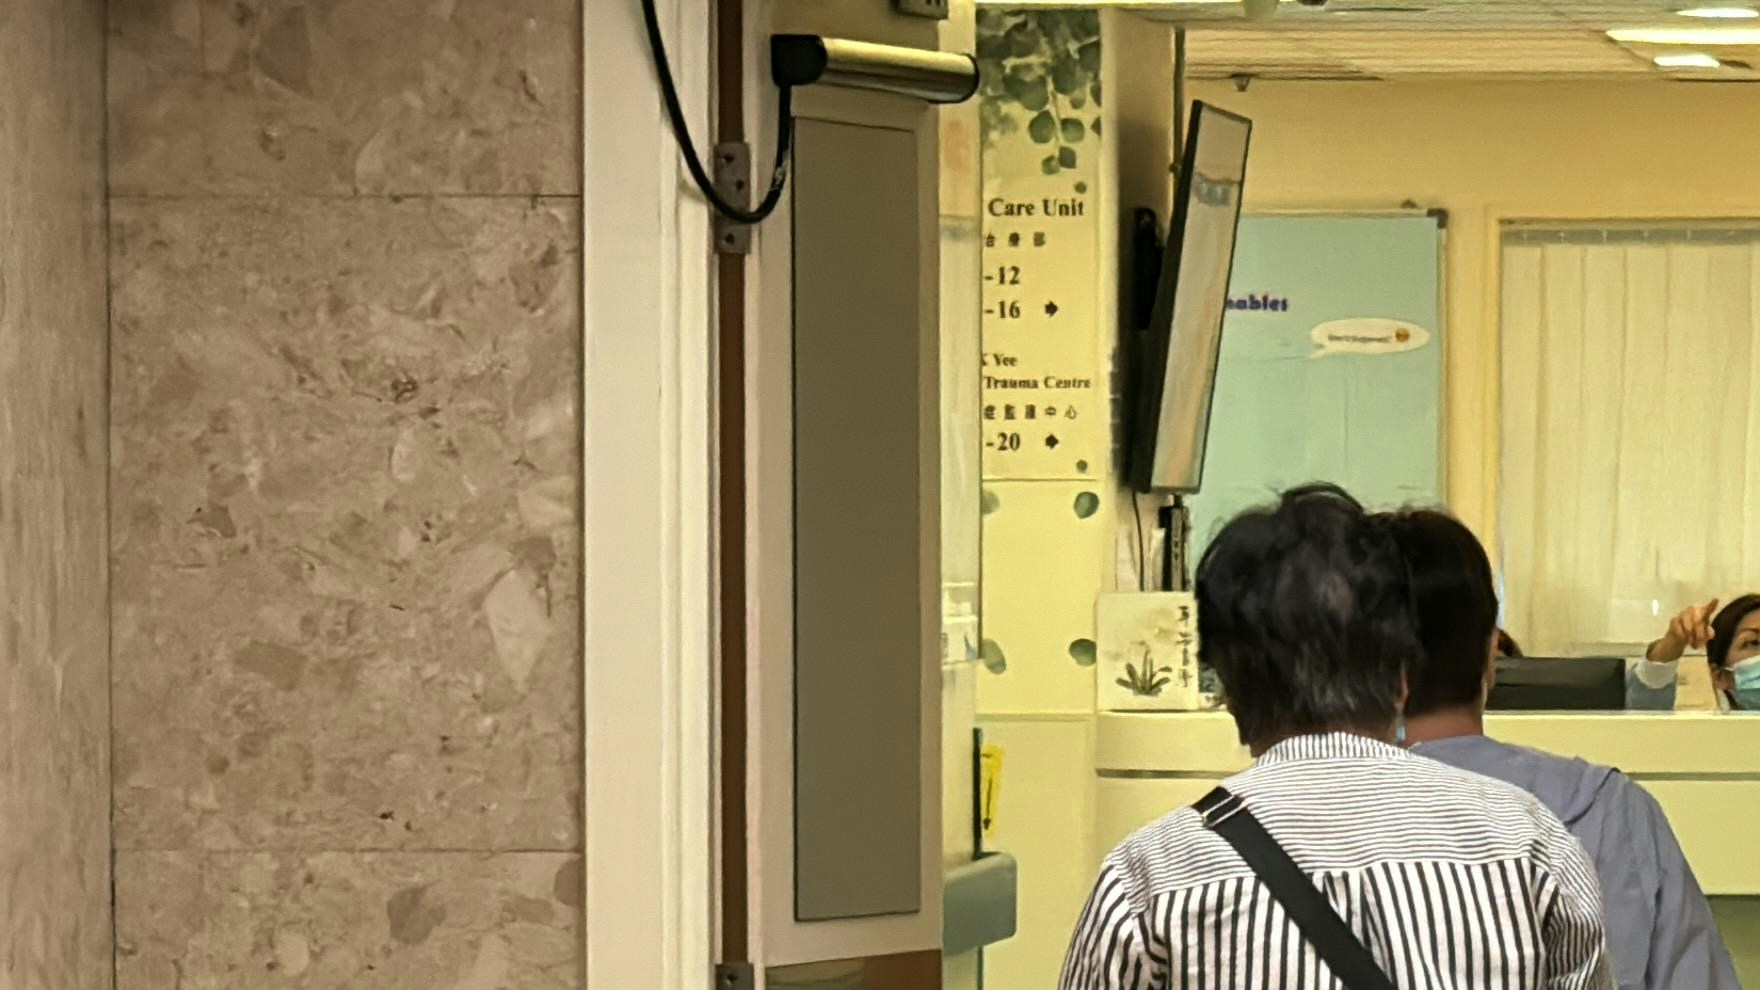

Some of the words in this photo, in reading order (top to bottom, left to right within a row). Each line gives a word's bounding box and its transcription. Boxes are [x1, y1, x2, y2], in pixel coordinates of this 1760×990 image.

[987, 198, 1035, 217] Care
[1043, 198, 1084, 217] Unit
[984, 376, 1039, 389] Trauma
[1044, 376, 1091, 389] Centre
